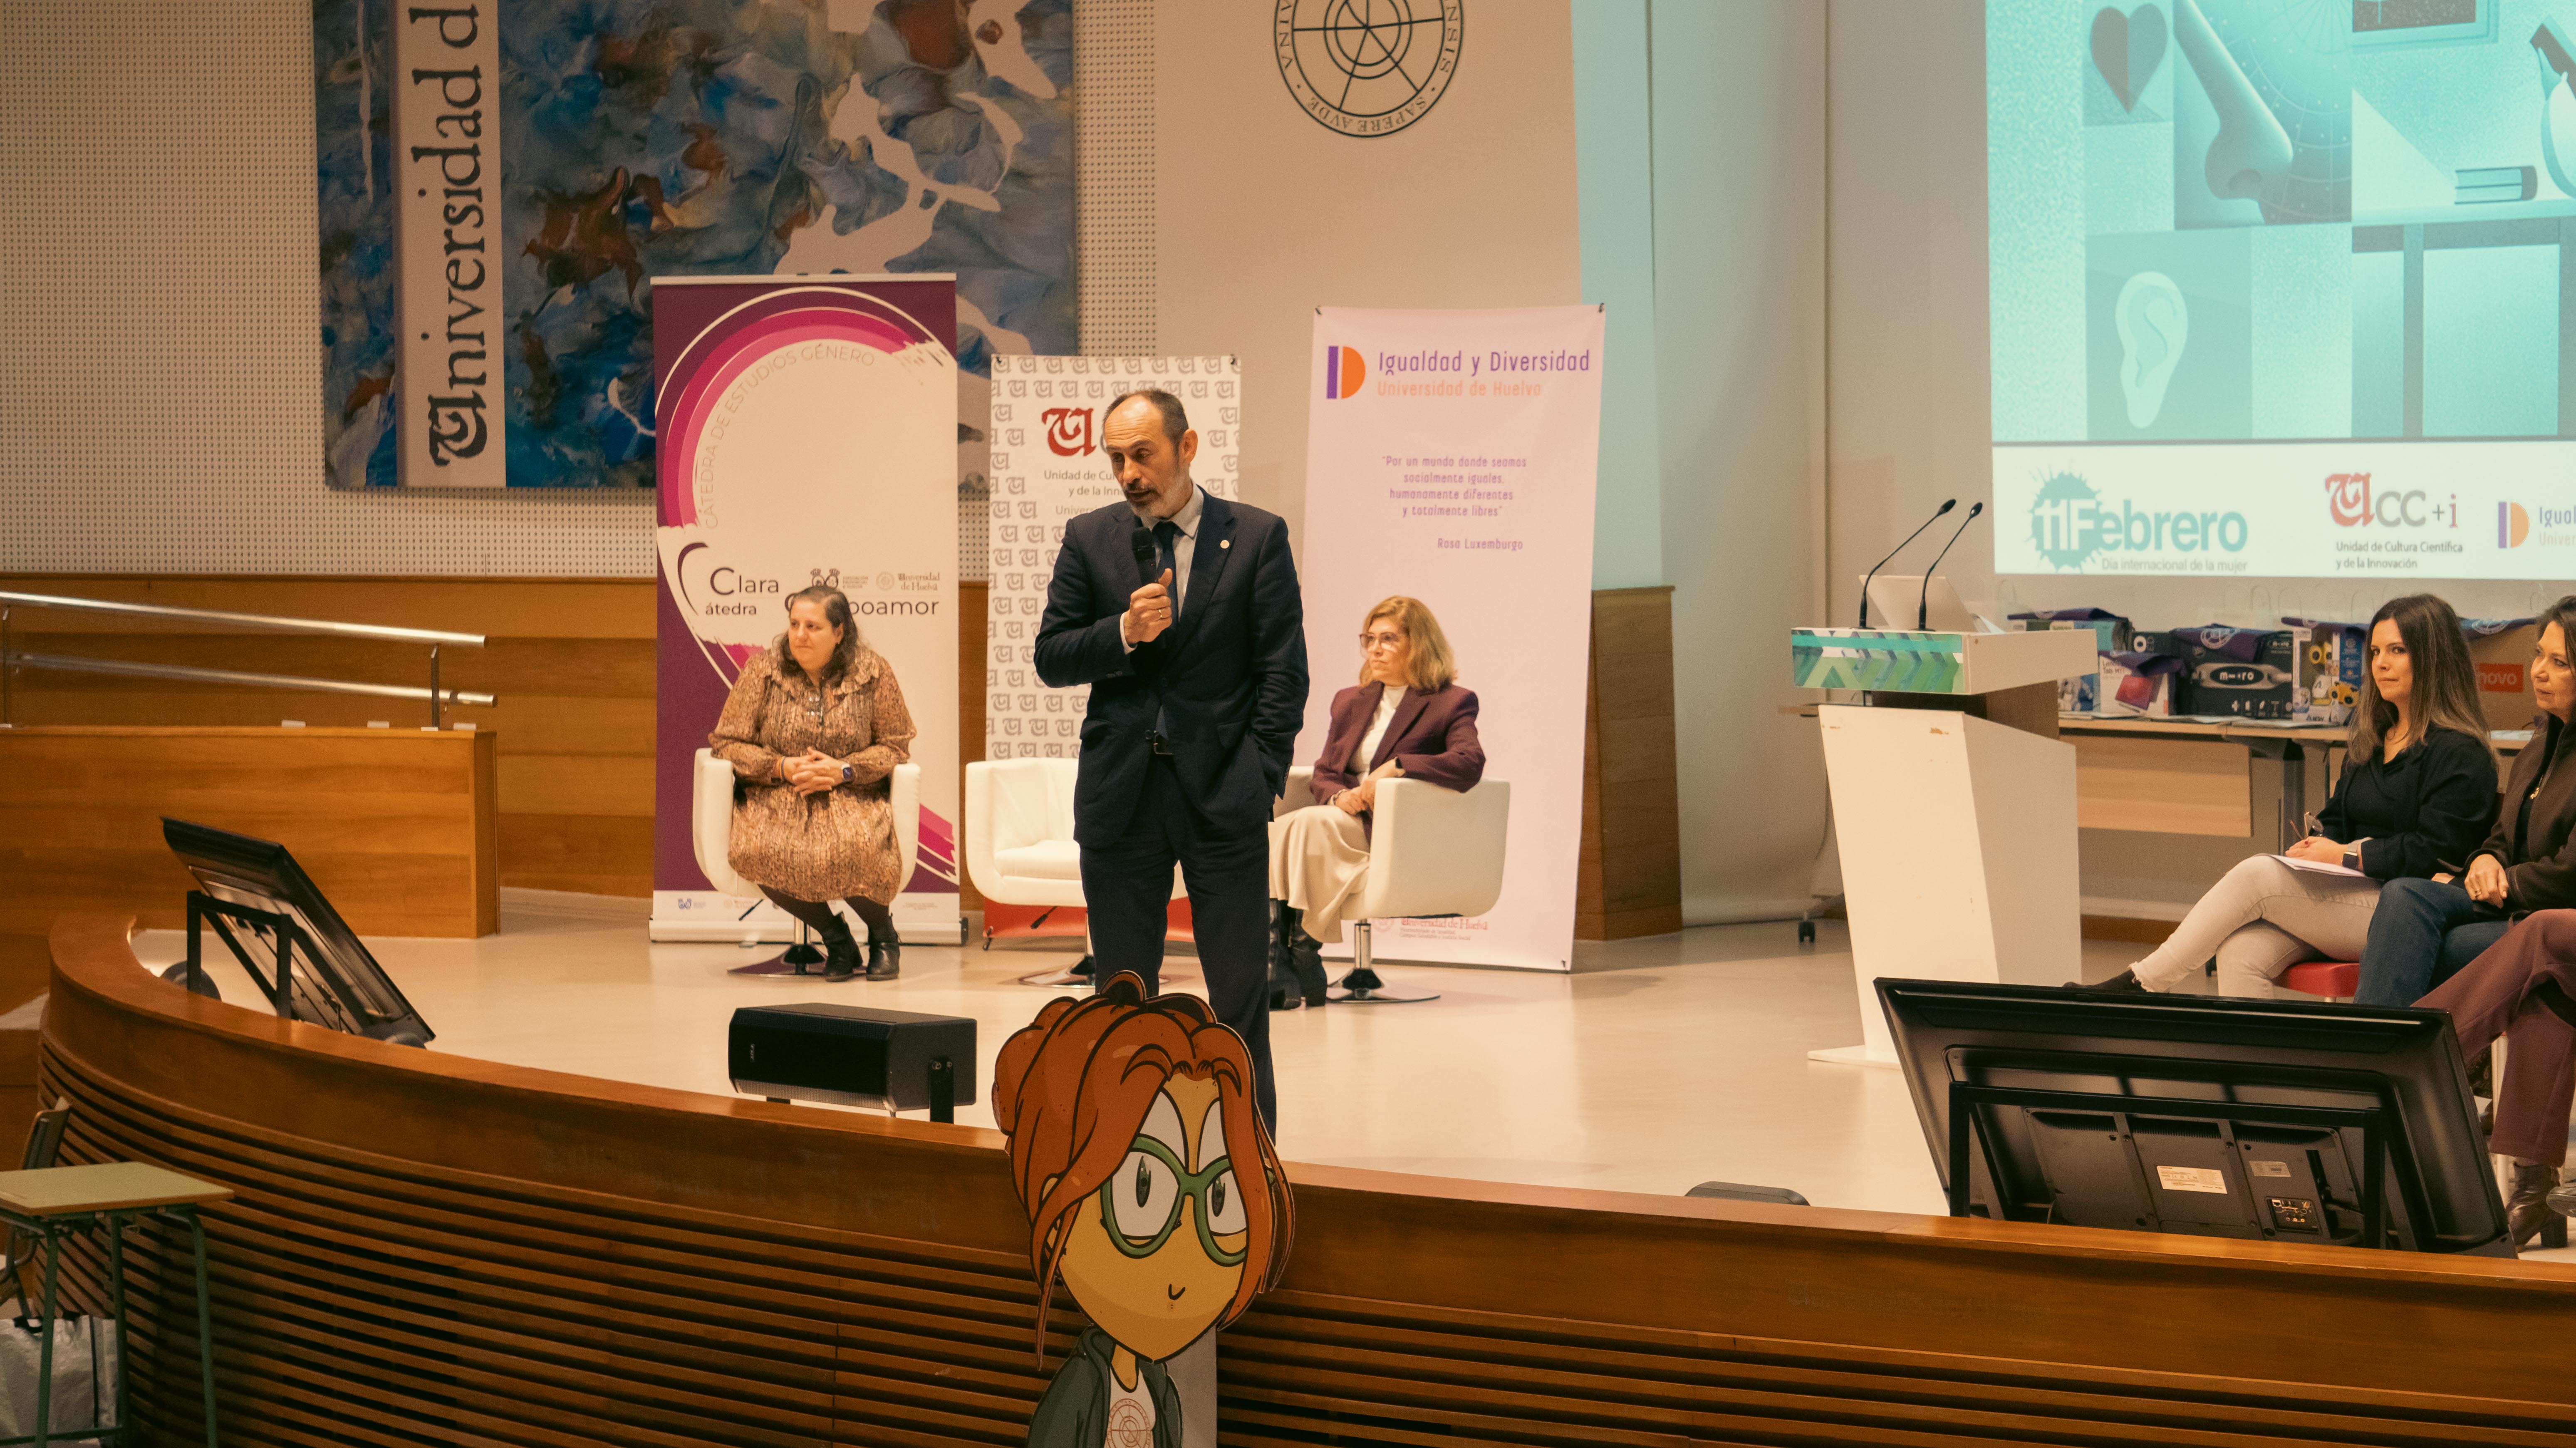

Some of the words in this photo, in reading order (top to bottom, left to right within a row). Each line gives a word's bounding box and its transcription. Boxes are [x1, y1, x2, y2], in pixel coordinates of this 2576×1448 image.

[1357, 96, 1426, 132] SAPERE
[411, 64, 487, 466] Universidad
[1379, 350, 1461, 376] Igualdad
[1471, 355, 1480, 377] y
[1490, 350, 1589, 372] Diversidad
[1378, 380, 1463, 397] Universidad
[1469, 380, 1486, 397] de
[1493, 380, 1542, 397] Huelva
[698, 444, 719, 530] CÁTEDRA
[711, 414, 731, 440] DE
[725, 351, 797, 413] ESTUDIOS
[801, 343, 875, 366] GÉNERO
[1406, 458, 1418, 466] un
[1422, 456, 1454, 467] mundo
[1458, 456, 1488, 467] donde
[1491, 458, 1527, 467] seamos
[1044, 470, 1080, 480] Unidad
[1083, 470, 1096, 480] de
[1404, 472, 1464, 483] socialmente
[1069, 488, 1075, 497] y
[1077, 486, 1090, 495] de
[1092, 486, 1100, 496] la
[1390, 488, 1459, 500] humanamente
[1463, 488, 1513, 500] diferentes
[1402, 507, 1407, 518] y
[1412, 505, 1468, 516] totalmente
[1437, 538, 1460, 549] Rosa
[1464, 538, 1523, 551] Luxemburgo
[2336, 541, 2368, 552] Unidad
[2371, 541, 2382, 552] de
[2384, 541, 2418, 552] Cultura
[2420, 541, 2463, 553] Científica
[2122, 558, 2187, 571] internacional
[2190, 558, 2203, 571] de
[2205, 559, 2214, 571] la
[2217, 559, 2248, 573] mujer
[2336, 559, 2342, 570] y
[2343, 557, 2355, 569] de
[2357, 557, 2365, 569] la
[2367, 557, 2418, 569] Innovación
[710, 567, 779, 595] Clara
